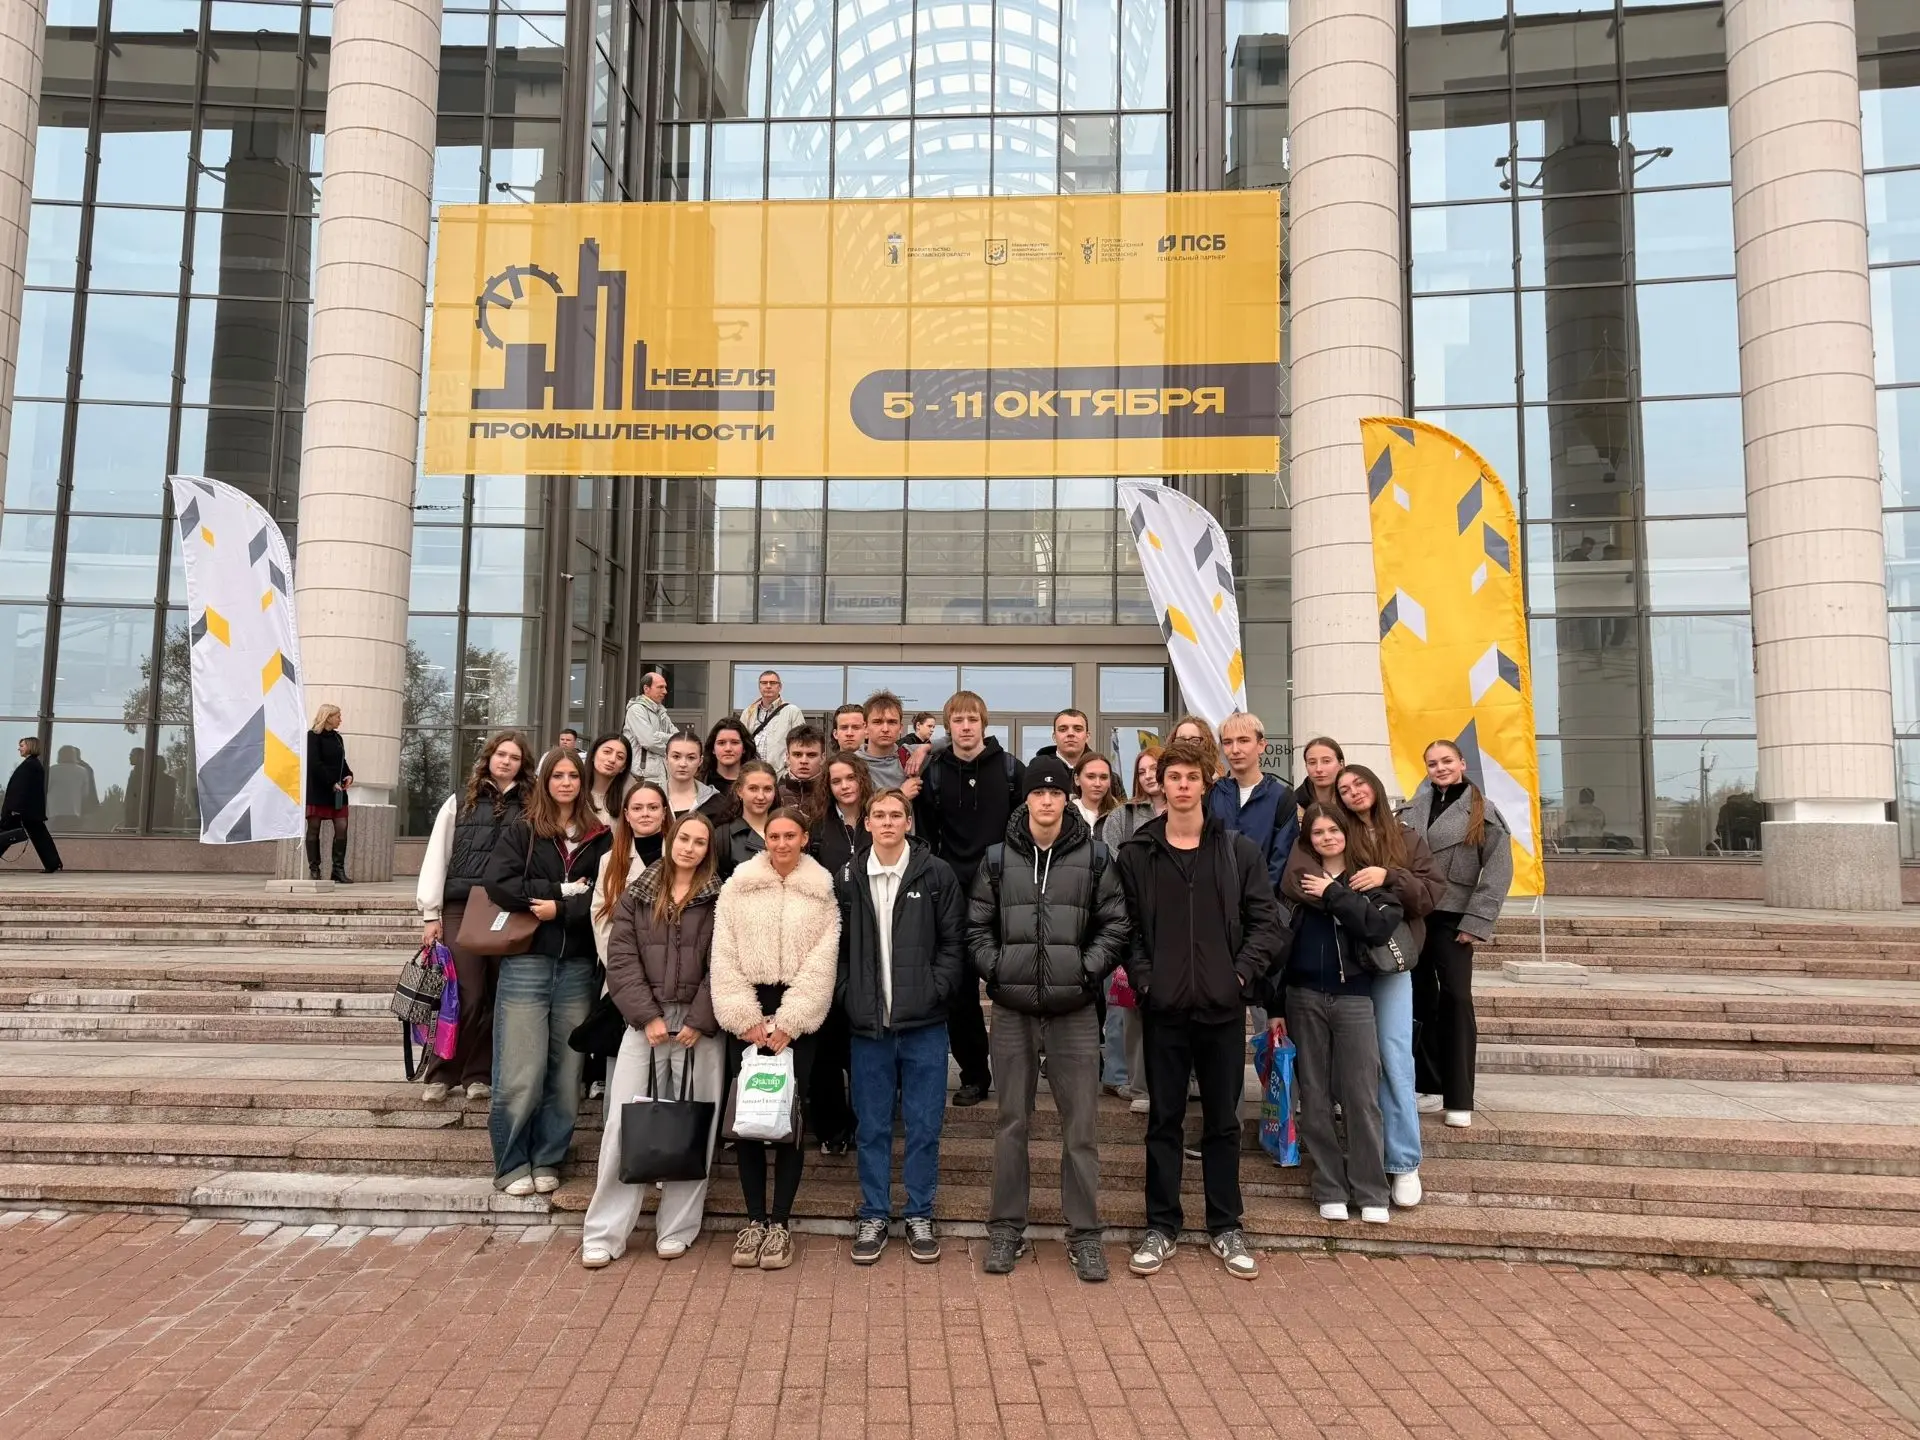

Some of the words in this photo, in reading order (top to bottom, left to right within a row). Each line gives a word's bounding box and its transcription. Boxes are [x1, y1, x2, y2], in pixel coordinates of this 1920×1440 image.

[1181, 234, 1226, 251] ПСБ
[651, 368, 776, 388] НЕДЕЛЯ
[883, 391, 914, 419] 5
[951, 391, 985, 418] 11
[994, 386, 1225, 418] ОКТЯБРЯ
[469, 422, 775, 441] ПРОМЫШЛЕННОСТИ
[906, 891, 921, 899] FILA
